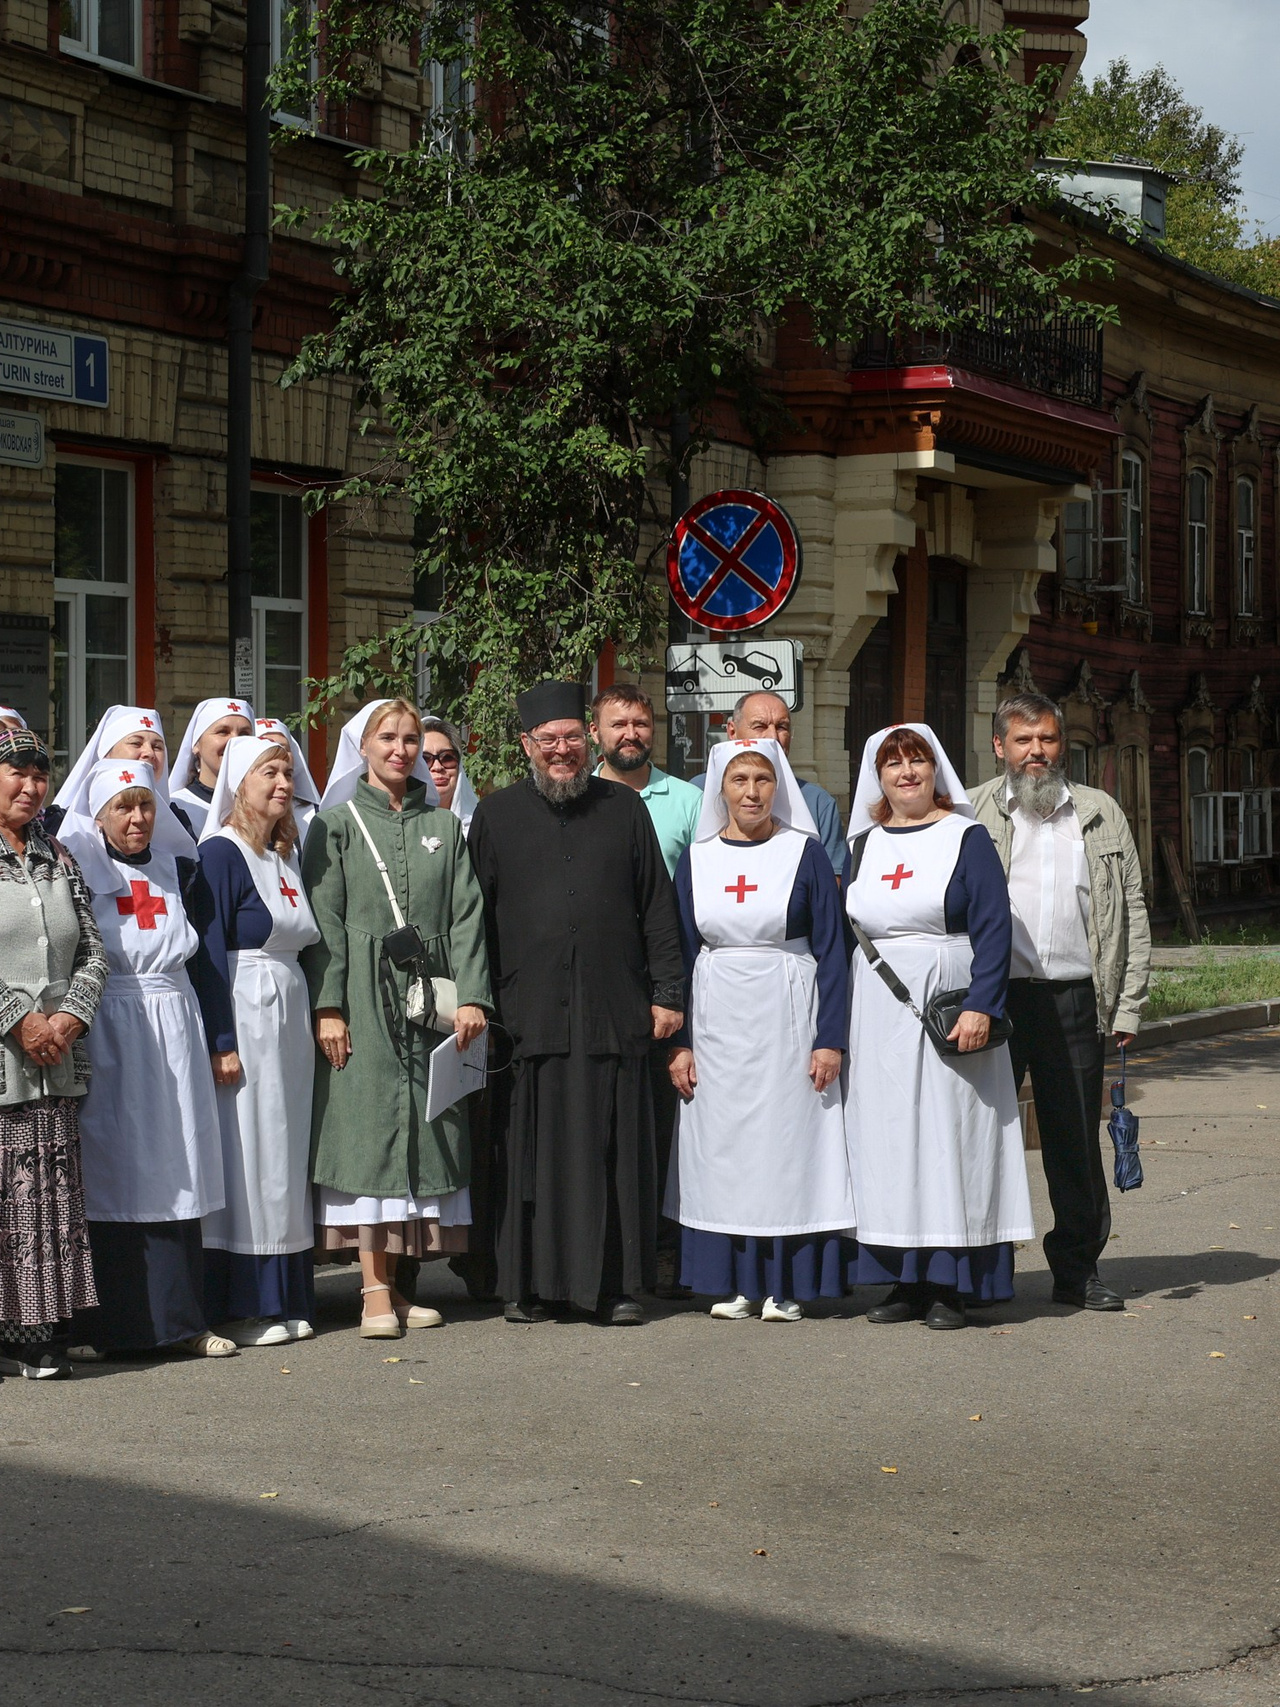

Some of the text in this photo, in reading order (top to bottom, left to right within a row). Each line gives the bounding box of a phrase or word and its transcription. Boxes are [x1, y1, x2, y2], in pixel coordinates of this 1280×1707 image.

[85, 352, 95, 388] 1
[33, 371, 65, 389] street
[27, 665, 48, 675] РОММ
